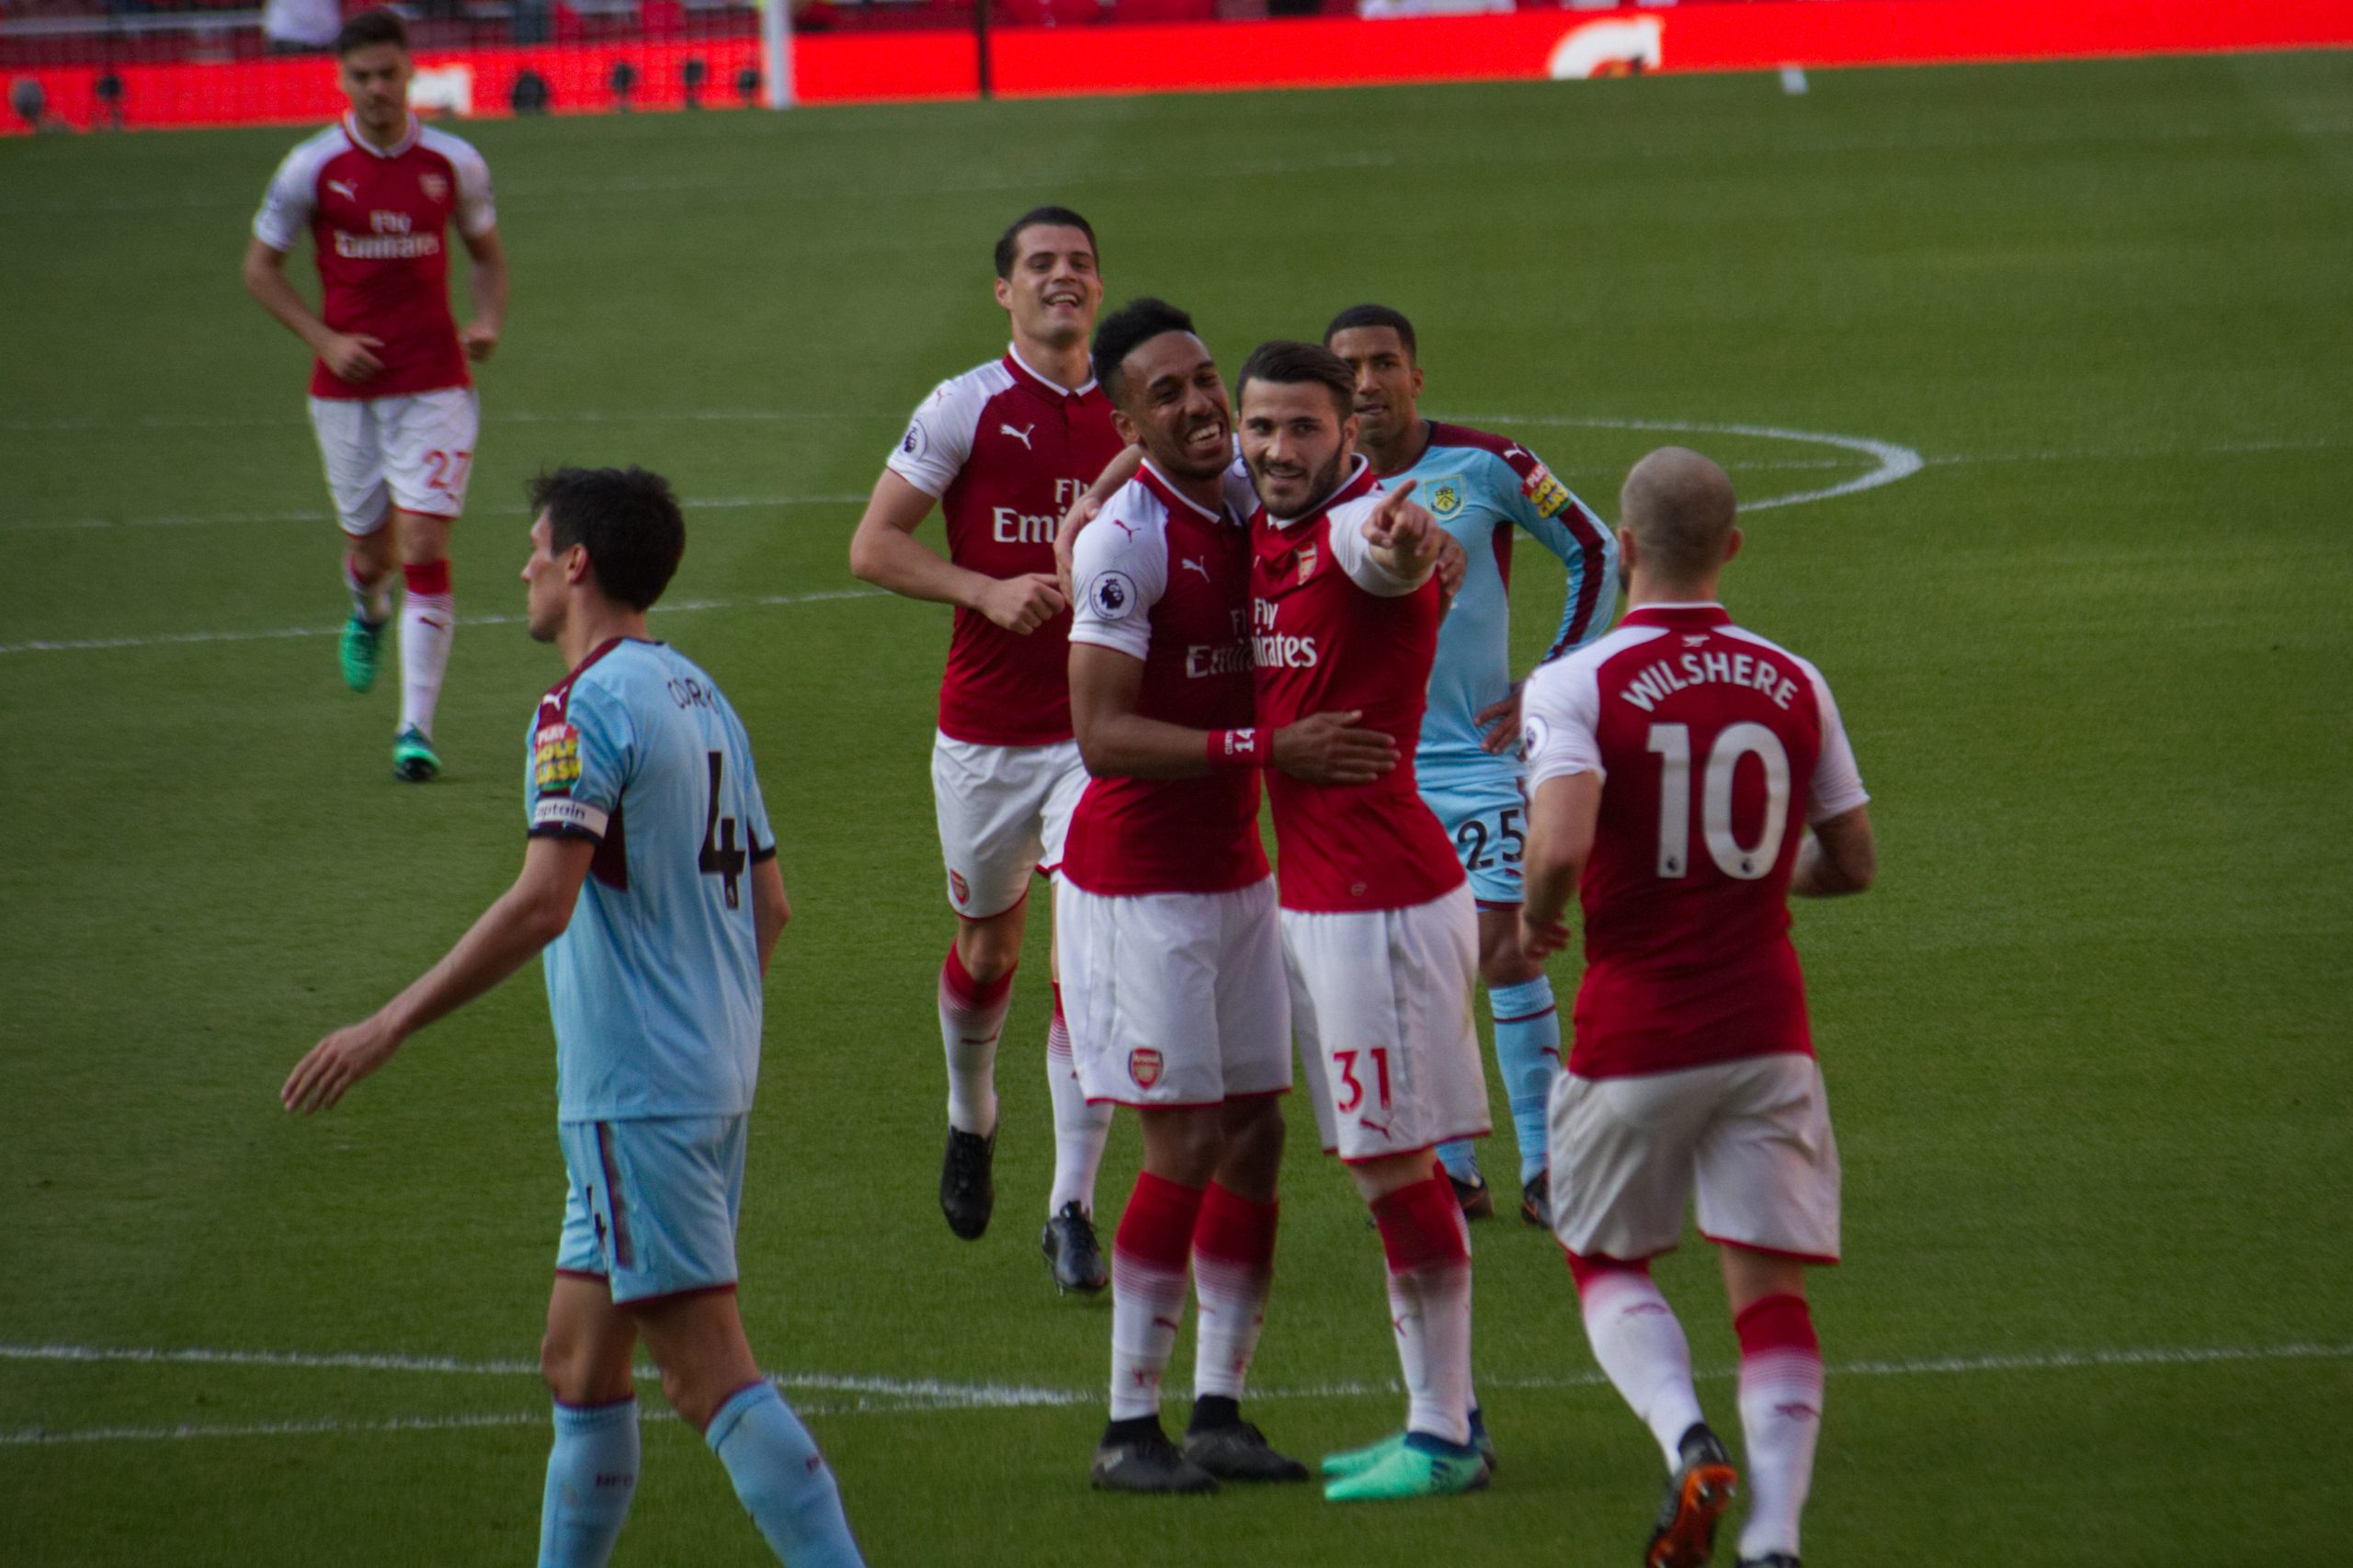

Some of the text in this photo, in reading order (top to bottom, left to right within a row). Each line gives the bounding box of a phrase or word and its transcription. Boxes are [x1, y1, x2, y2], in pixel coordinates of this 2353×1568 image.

[1054, 478, 1090, 504] Fl
[1230, 608, 1248, 635] Fl
[1254, 597, 1279, 631] Fly
[1620, 652, 1798, 712] WILSHERE
[1235, 728, 1256, 753] 14
[537, 802, 585, 821] aptain
[1646, 721, 1790, 880] 10
[699, 751, 746, 910] 4
[1458, 809, 1526, 871] 25
[1334, 1046, 1392, 1113] 31
